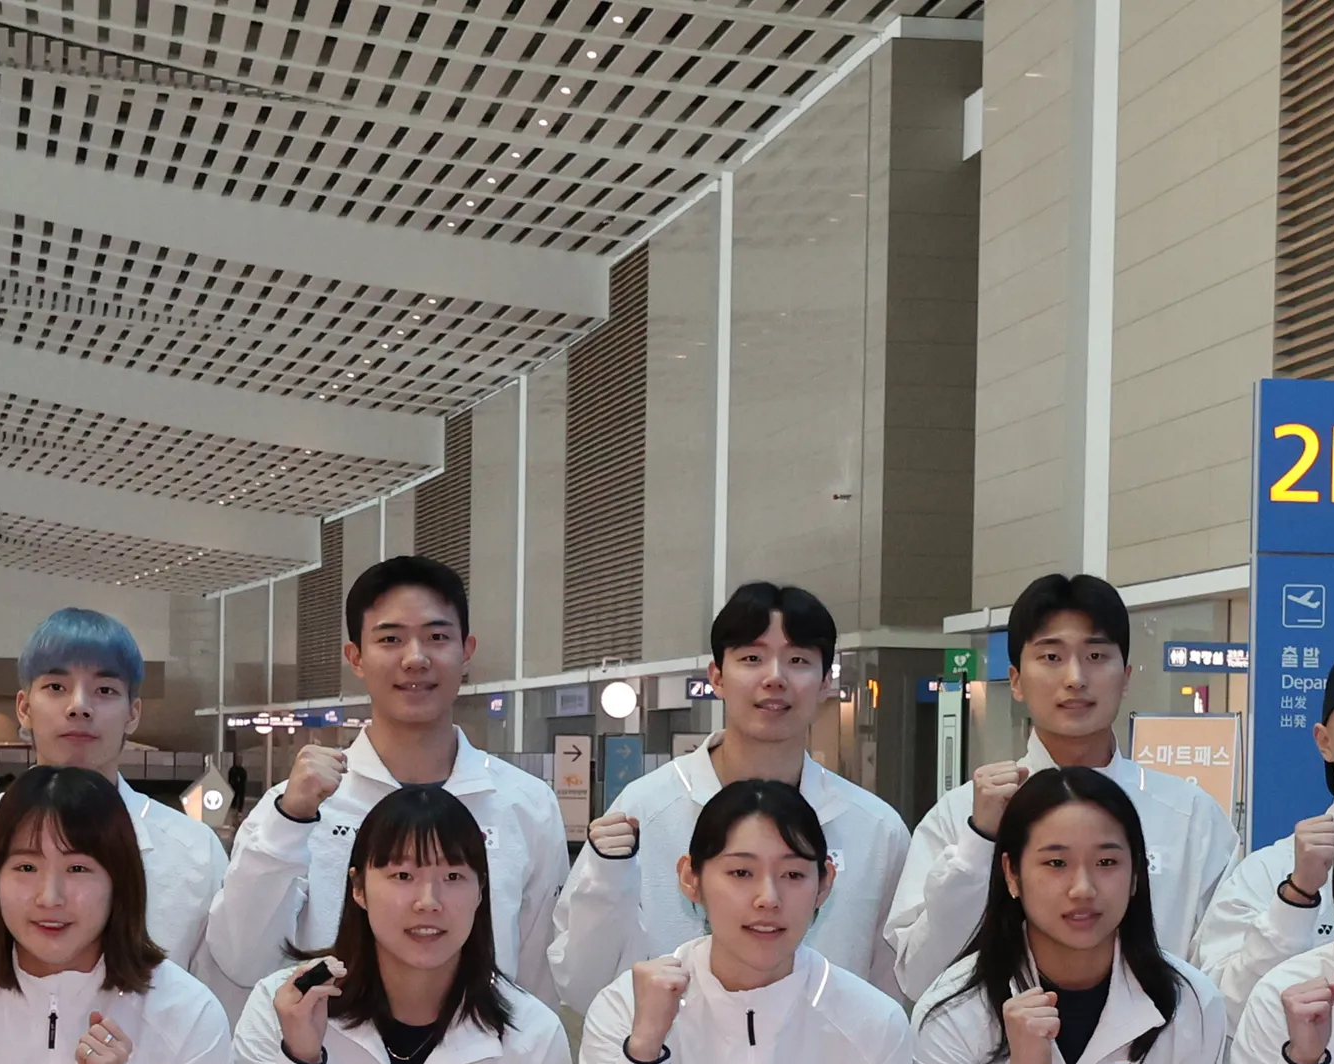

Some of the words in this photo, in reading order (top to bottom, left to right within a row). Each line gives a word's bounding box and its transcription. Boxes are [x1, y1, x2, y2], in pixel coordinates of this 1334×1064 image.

[1281, 646, 1320, 668] 출발
[1281, 674, 1328, 693] Depar
[1280, 695, 1307, 710] 出发
[1280, 714, 1307, 729] 出発
[1136, 745, 1230, 767] 스마트패스
